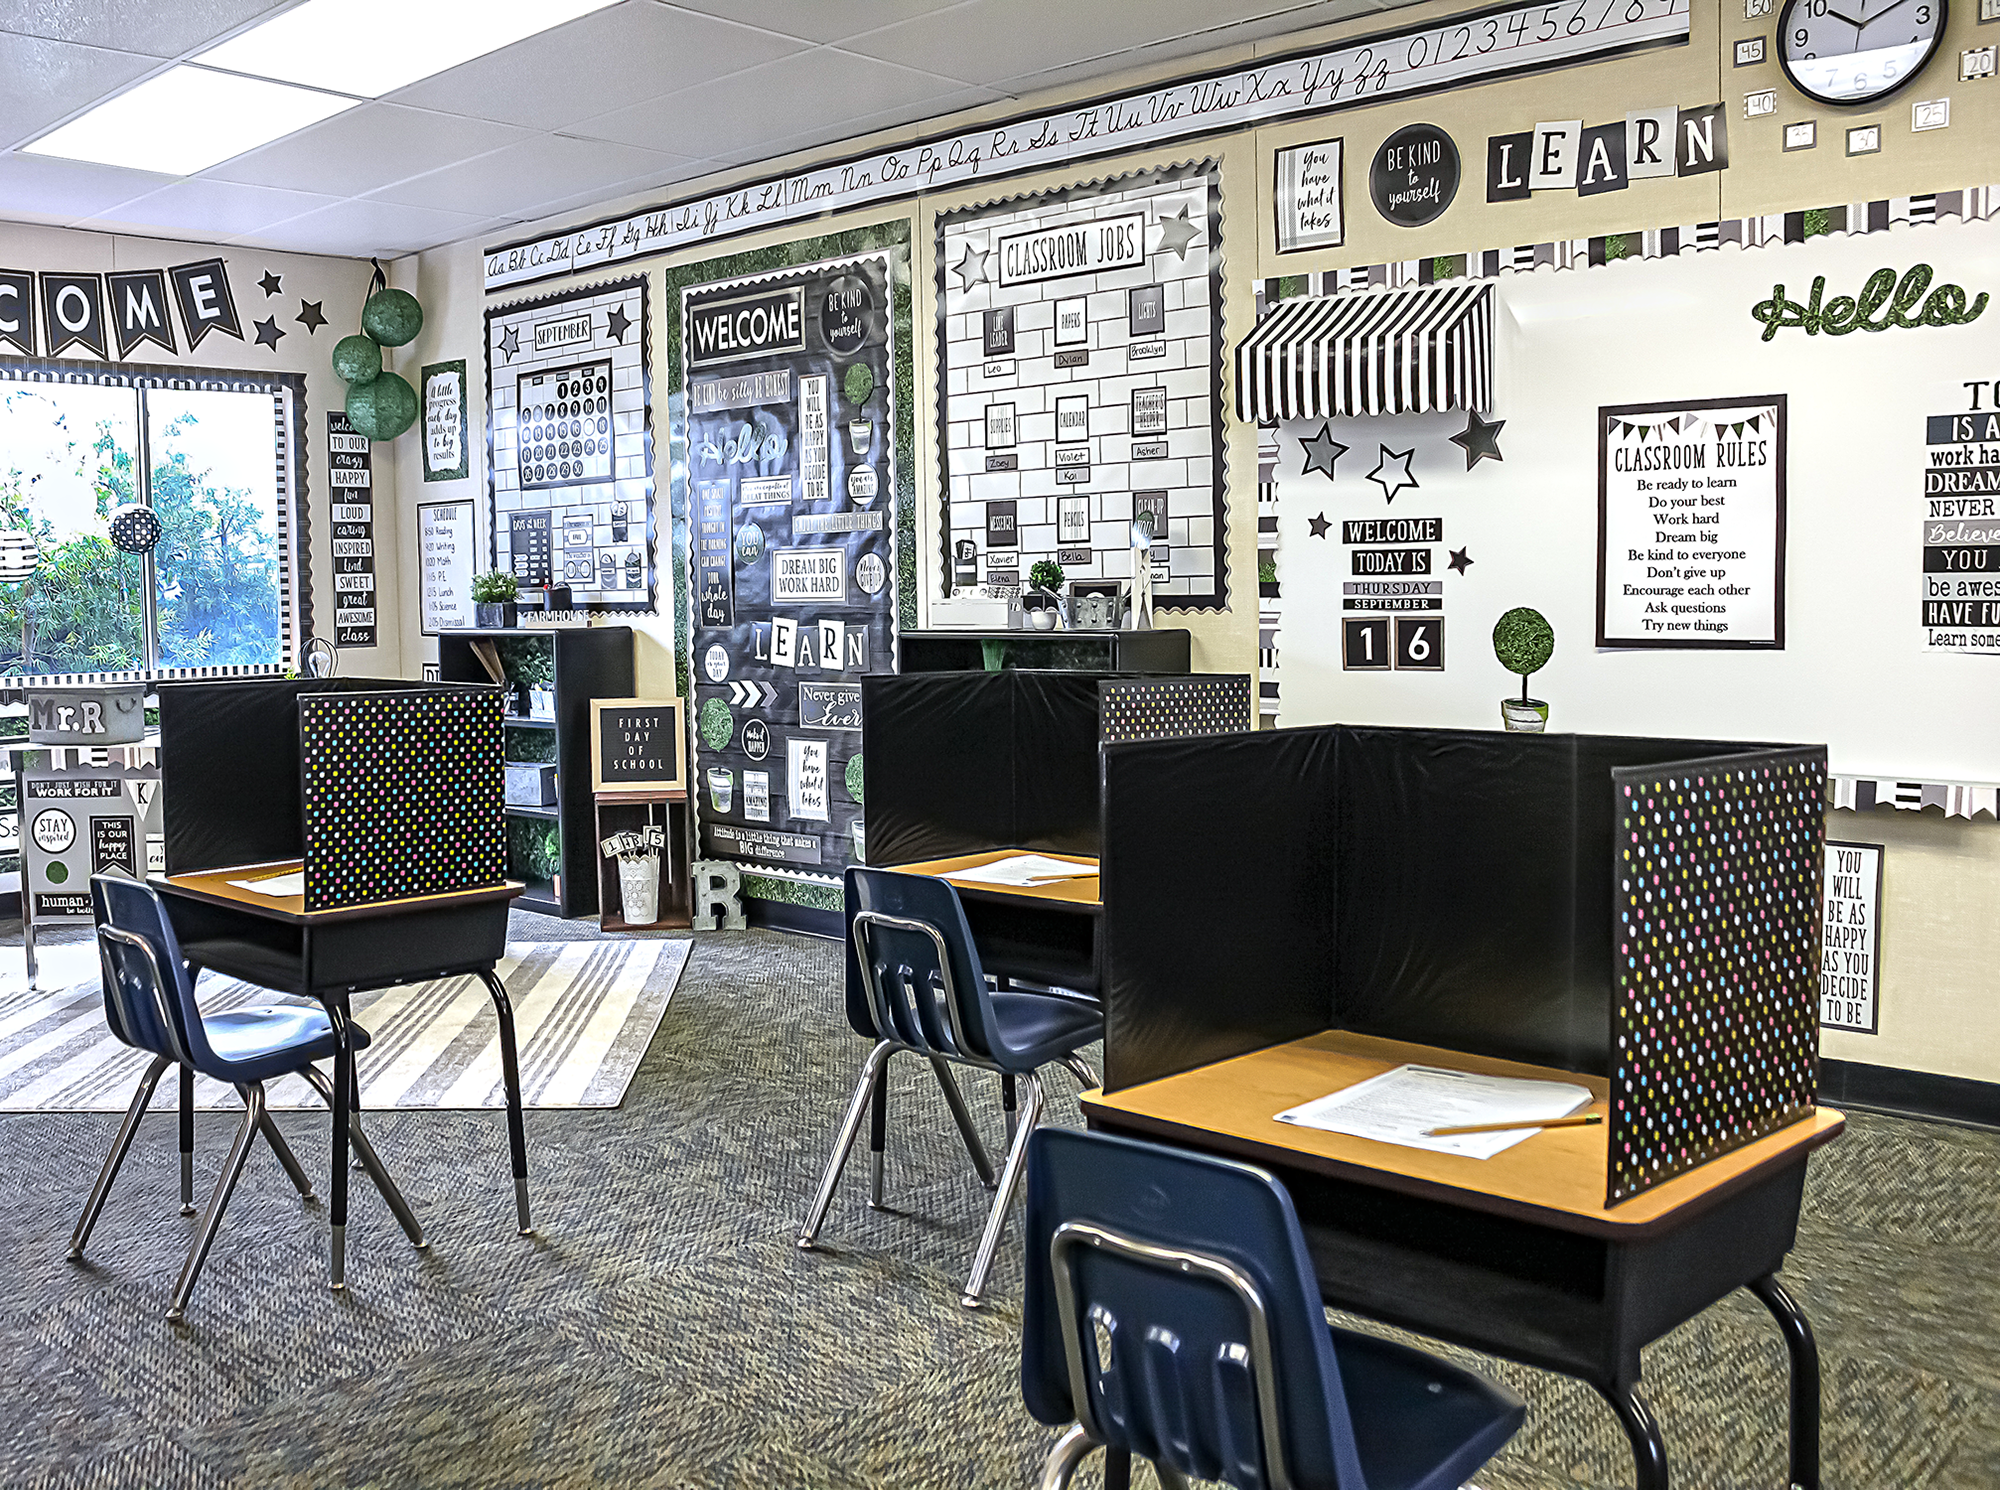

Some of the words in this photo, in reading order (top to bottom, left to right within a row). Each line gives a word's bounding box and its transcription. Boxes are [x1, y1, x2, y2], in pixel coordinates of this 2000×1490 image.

[1915, 6, 1930, 24] 3
[1794, 29, 1809, 47] 9
[1741, 43, 1760, 59] 45
[1967, 54, 1990, 73] 20
[1752, 95, 1771, 112] 40
[1922, 107, 1942, 124] 25
[1793, 127, 1809, 143] 35
[1857, 131, 1875, 149] 30
[1388, 146, 1402, 172] BE
[1408, 140, 1441, 167] KIND
[1496, 113, 1716, 190] LEARN
[1304, 151, 1330, 172] You
[1301, 172, 1330, 187] have
[1407, 170, 1419, 186] to
[1389, 177, 1441, 211] yourself
[1297, 195, 1323, 210] what
[1300, 211, 1333, 230] takes
[1007, 230, 1088, 278] CLASSROOM
[1097, 223, 1134, 264] JOBS
[828, 293, 839, 312] BE
[841, 289, 862, 309] KIND
[1751, 263, 1990, 342] Hello
[841, 311, 848, 324] to
[1061, 311, 1080, 330] PAPERS
[538, 320, 588, 345] SEPTEMBER
[695, 302, 799, 353] WELCOME
[830, 320, 862, 342] yourself
[1131, 344, 1164, 357] Brooklyn
[1058, 355, 1083, 365] Dylan
[988, 365, 1001, 373] Leo
[1060, 410, 1086, 429] CALENDAR
[332, 437, 343, 449] TO
[349, 437, 366, 449] OUR
[1136, 446, 1160, 456] Asher
[336, 454, 363, 469] crazy
[989, 459, 1010, 469] Zoey
[1058, 452, 1086, 462] Violet
[1614, 443, 1706, 473] CLASSROOM
[1716, 440, 1767, 468] RULES
[1930, 445, 1974, 467] work
[335, 472, 365, 484] HAPPY
[1637, 479, 1653, 491] Be
[1656, 479, 1688, 492] ready
[1692, 479, 1703, 488] to
[1707, 477, 1737, 488] learn
[1649, 496, 1667, 508] Do
[1670, 497, 1697, 509] your
[1701, 495, 1725, 506] best
[1929, 499, 1995, 518] NEVER
[341, 507, 363, 519] LOUD
[433, 507, 457, 521] SCHEDULE
[1064, 511, 1085, 528] PENCILS
[337, 525, 365, 538] caring
[741, 532, 759, 545] YOU
[1348, 520, 1436, 542] WELCOME
[1655, 531, 1696, 543] Dream
[1700, 530, 1718, 544] big
[335, 542, 370, 554] INSPIRED
[742, 546, 759, 557] can
[1060, 551, 1086, 561] Bella
[1628, 549, 1644, 561] Be
[1648, 548, 1674, 561] kind
[1677, 550, 1689, 560] to
[1692, 550, 1746, 562] everyone
[781, 559, 816, 575] DREAM
[819, 558, 837, 574] BIG
[989, 555, 1014, 565] Xavier
[1357, 552, 1405, 573] TODAY
[1412, 552, 1426, 572] IS
[1941, 550, 1988, 570] YOU
[340, 576, 369, 588] SWEET
[778, 577, 808, 593] WORK
[811, 577, 839, 592] HARD
[1353, 582, 1431, 594] THURSDAY
[1927, 576, 1950, 597] be
[701, 586, 728, 602] whole
[1623, 584, 1684, 598] Encourage
[1688, 584, 1715, 596] each
[1719, 584, 1750, 596] other
[343, 591, 367, 608] great
[1354, 599, 1430, 609] SEPTEMBER
[338, 612, 373, 623] AWESOME
[527, 610, 589, 622] FARMHOUSE
[707, 603, 725, 622] day
[1928, 602, 1973, 625] HAVE
[341, 627, 370, 641] class
[1642, 619, 1664, 632] Try
[1667, 621, 1691, 631] new
[1694, 619, 1729, 633] things
[1928, 628, 1968, 646] Learn
[754, 625, 864, 667] LEARN
[804, 688, 835, 702] Never
[837, 689, 860, 705] give
[618, 717, 660, 729] FIRST
[624, 732, 650, 742] DAY
[628, 746, 644, 756] OF
[613, 759, 663, 770] SCHOOL
[36, 788, 72, 798] WORK
[74, 788, 98, 797] FOR
[99, 787, 114, 797] IT
[137, 782, 147, 804] K
[39, 818, 69, 833] STAY
[102, 821, 122, 830] THIS
[38, 830, 69, 843] inspired
[98, 840, 128, 851] happy
[739, 842, 753, 855] BIG
[100, 852, 128, 860] PLACE
[1837, 850, 1862, 874] YOU
[41, 895, 85, 908] human
[691, 859, 747, 931] R
[1825, 925, 1867, 951] HAPPY
[1821, 974, 1868, 1001] DECIDE
[1826, 999, 1841, 1021] TO
[1847, 1001, 1862, 1025] BE
